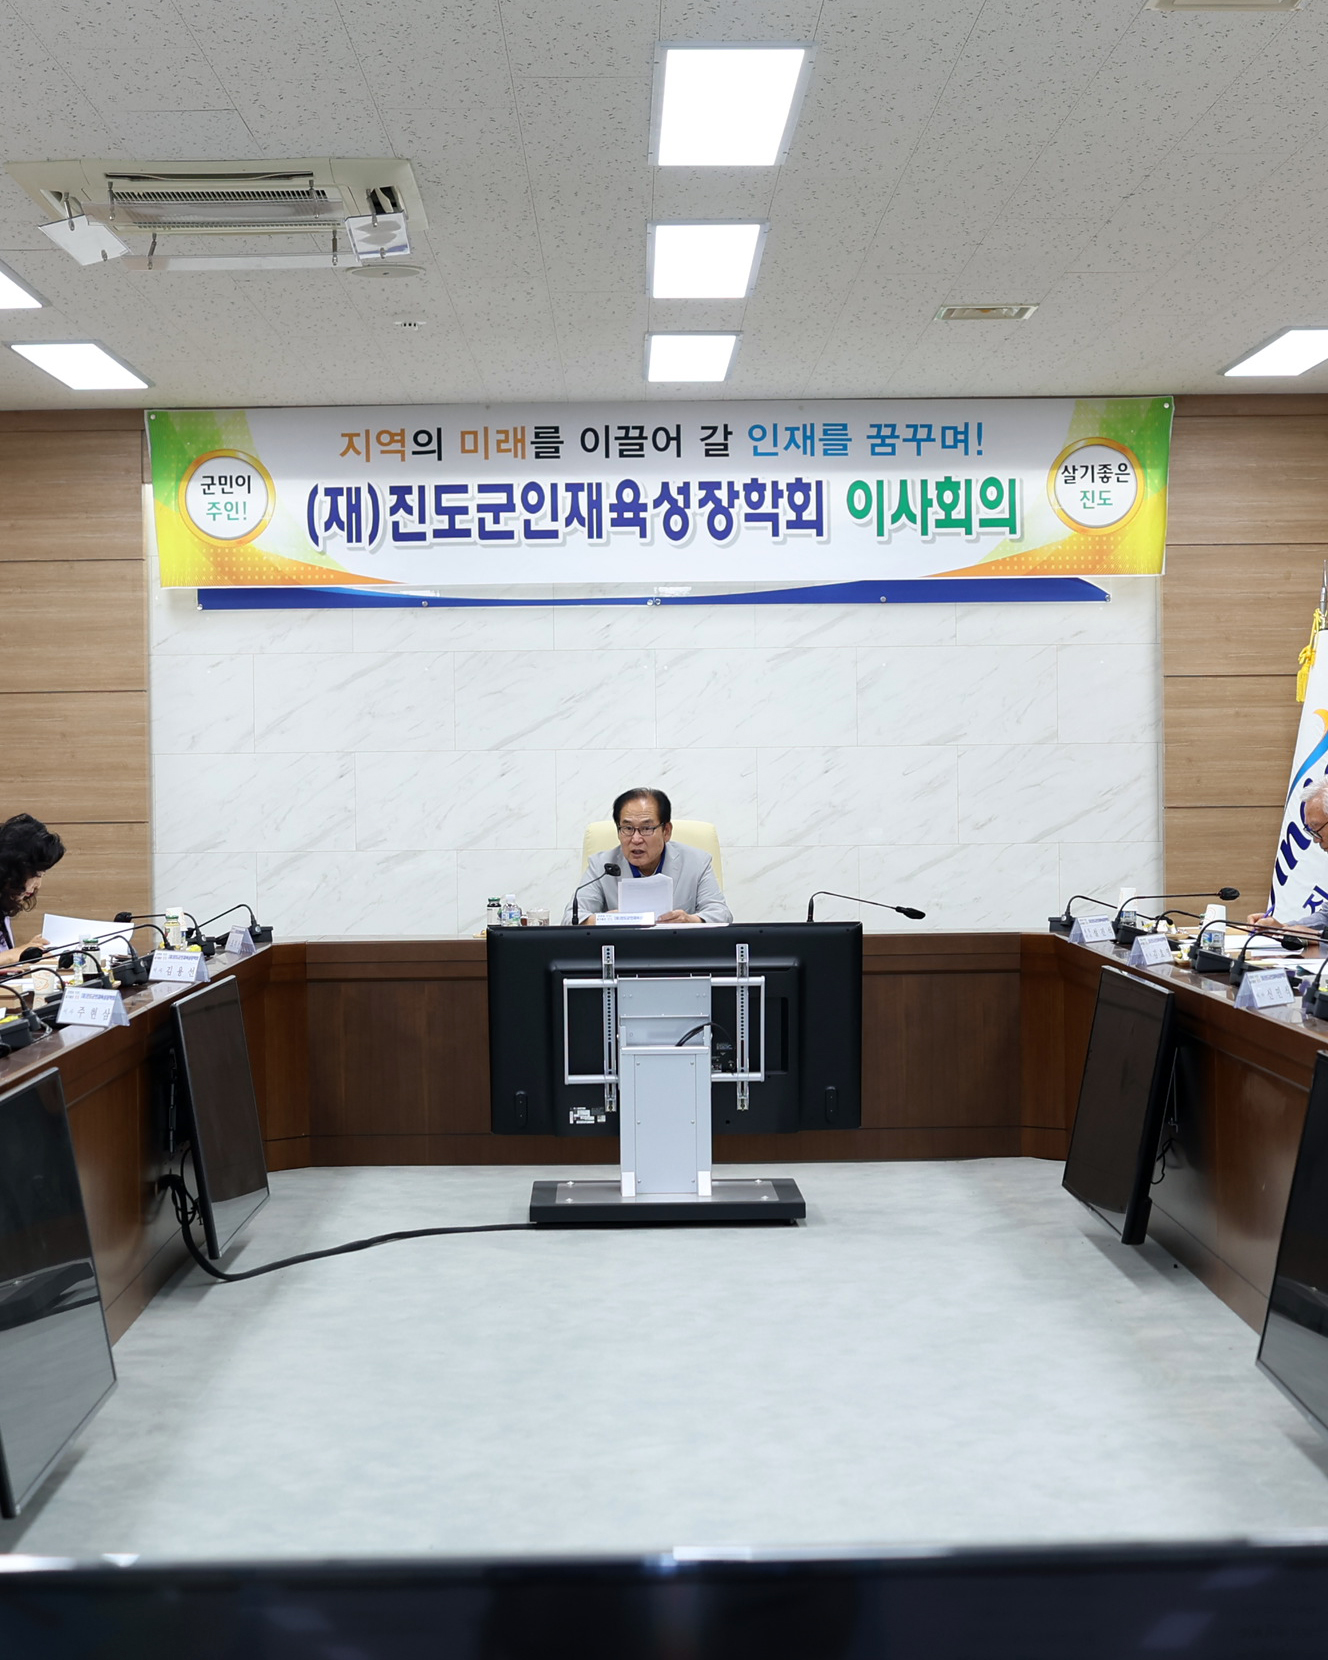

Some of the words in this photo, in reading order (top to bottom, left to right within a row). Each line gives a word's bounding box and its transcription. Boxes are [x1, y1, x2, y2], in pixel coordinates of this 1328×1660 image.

[339, 427, 442, 462] 지역의
[460, 425, 564, 460] 미래를
[580, 424, 682, 458] 이끌어
[699, 423, 733, 458] 갈
[747, 422, 852, 457] 인재를
[866, 421, 983, 457] 꿈꾸며!
[200, 474, 251, 495] 군민이
[1061, 462, 1131, 485] 살기좋은
[307, 477, 824, 546] (재)진도군인재육성장학회
[846, 475, 1017, 537] 이사회의
[1079, 489, 1113, 510] 진도
[205, 501, 247, 522] 주인!
